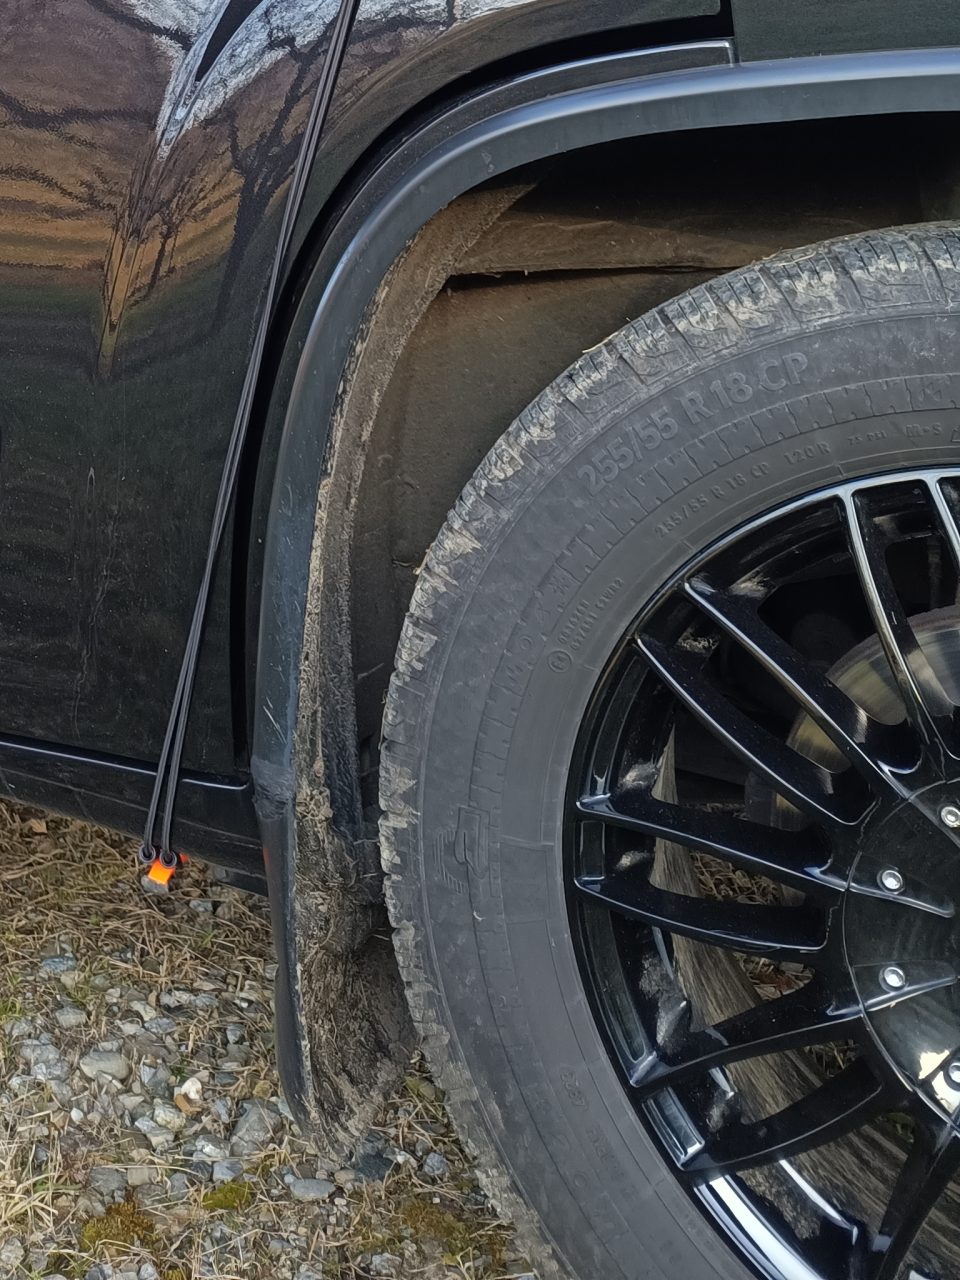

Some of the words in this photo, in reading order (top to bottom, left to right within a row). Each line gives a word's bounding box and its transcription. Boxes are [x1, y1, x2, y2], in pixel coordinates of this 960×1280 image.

[577, 408, 679, 496] 255/55
[681, 389, 715, 424] R
[709, 372, 753, 409] 18
[758, 352, 809, 392] CP
